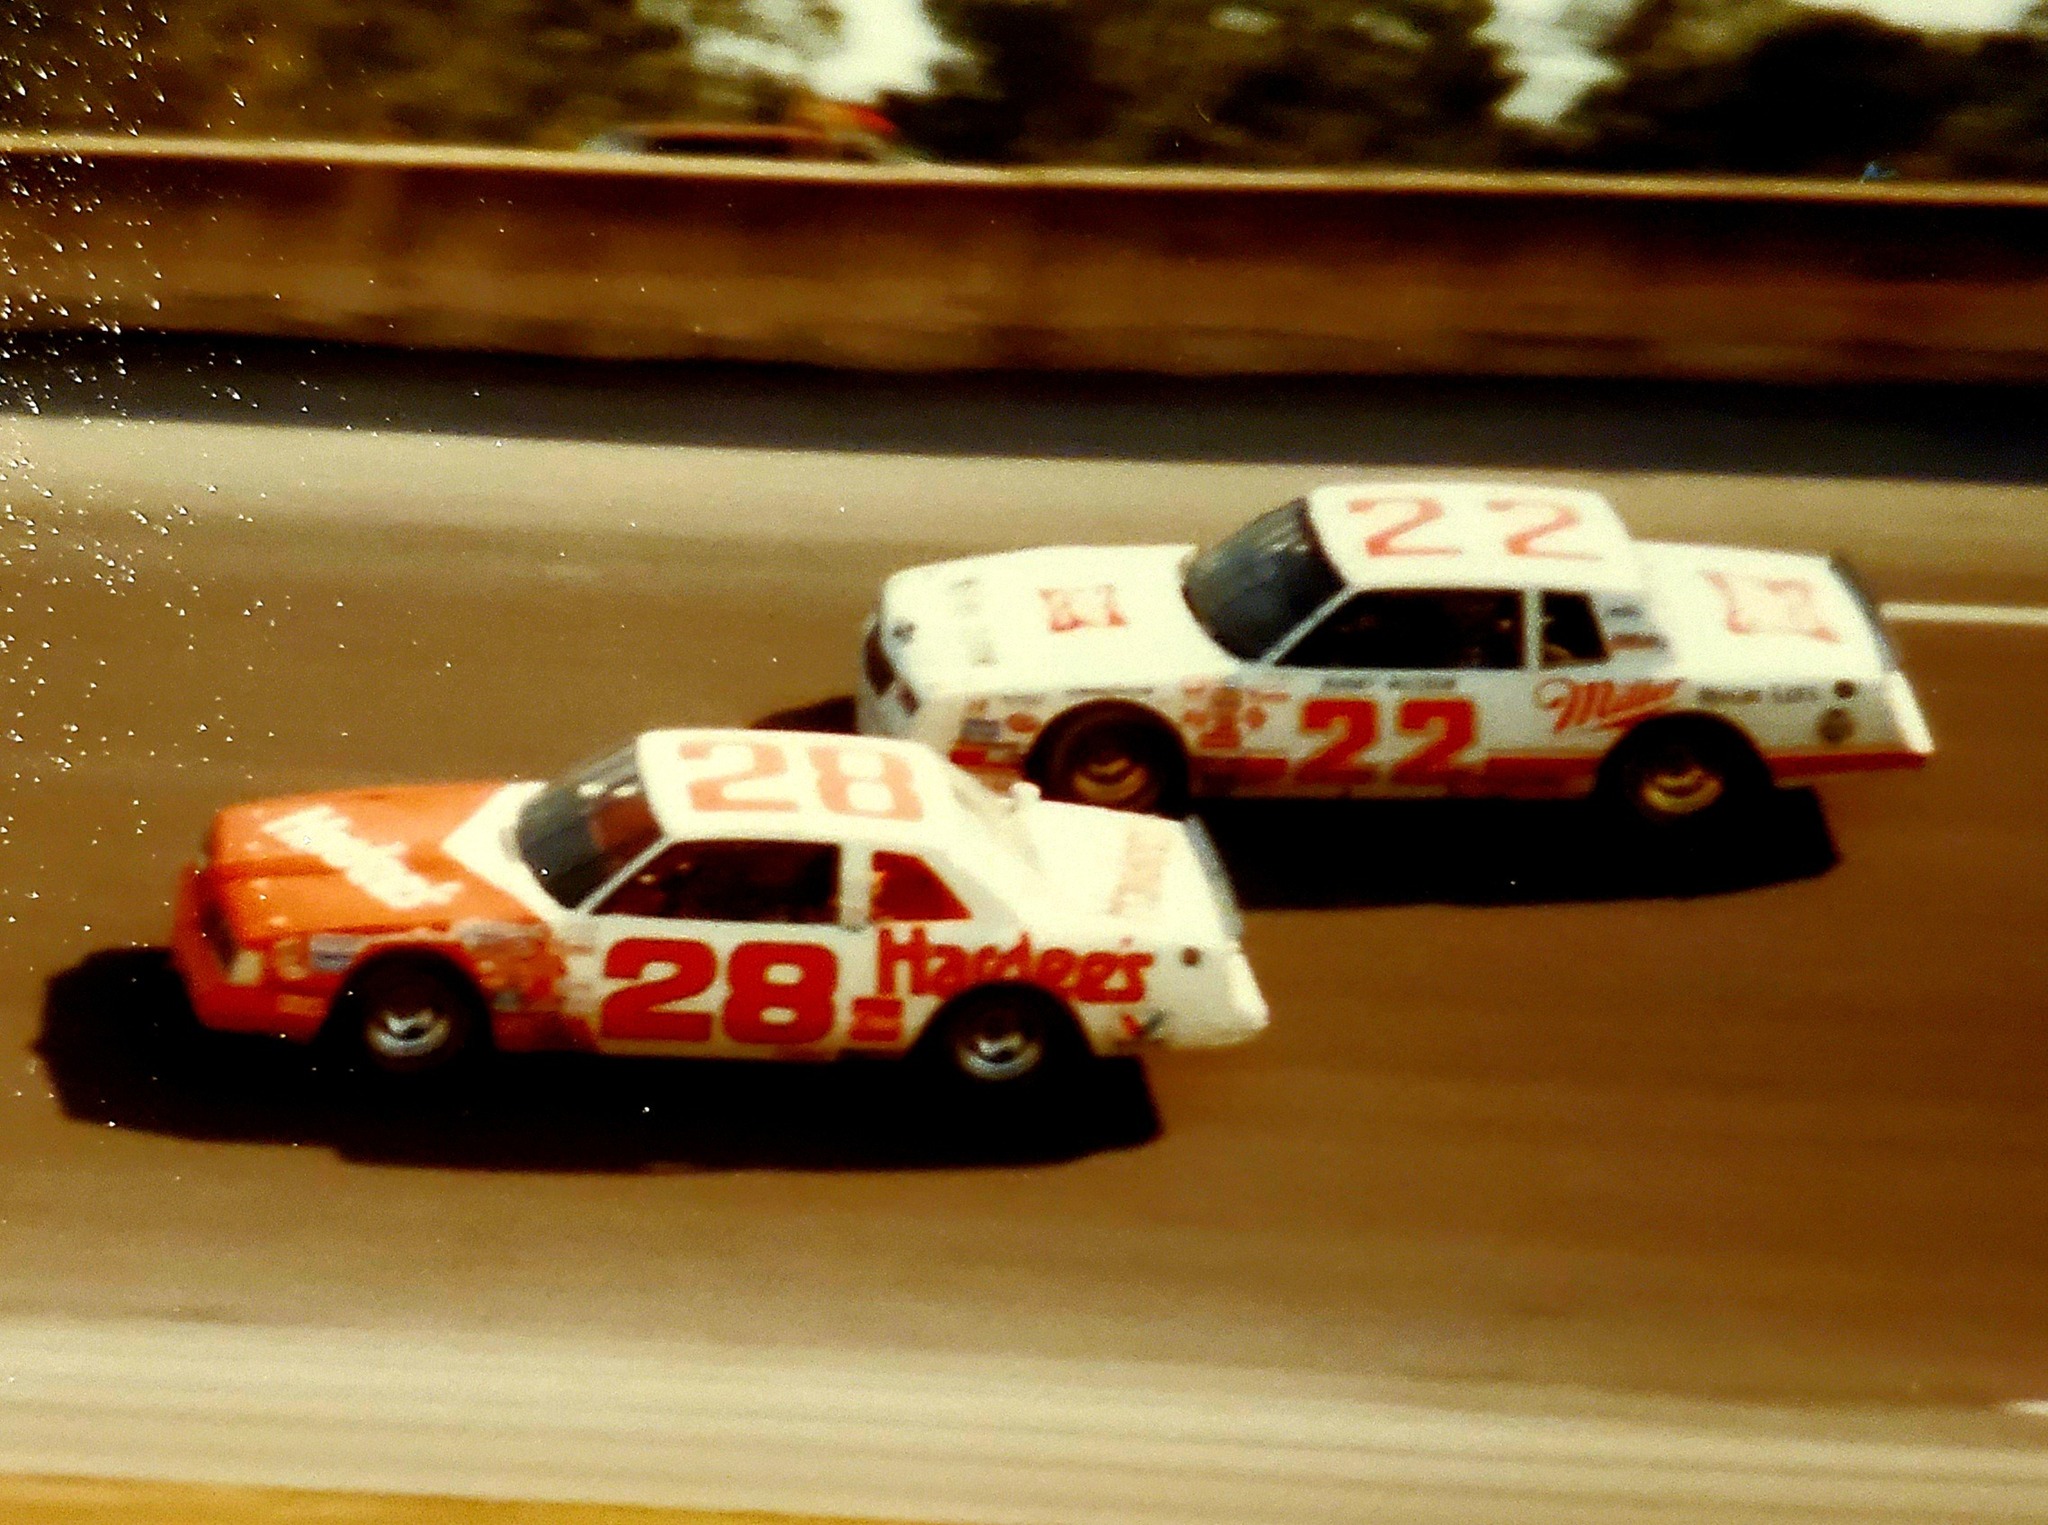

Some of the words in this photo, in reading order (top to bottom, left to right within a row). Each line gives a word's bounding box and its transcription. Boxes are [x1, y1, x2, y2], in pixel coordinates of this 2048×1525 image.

[1347, 496, 1603, 561] 22
[677, 740, 924, 823] 28
[1296, 697, 1478, 787] 22
[602, 937, 839, 1045] 28
